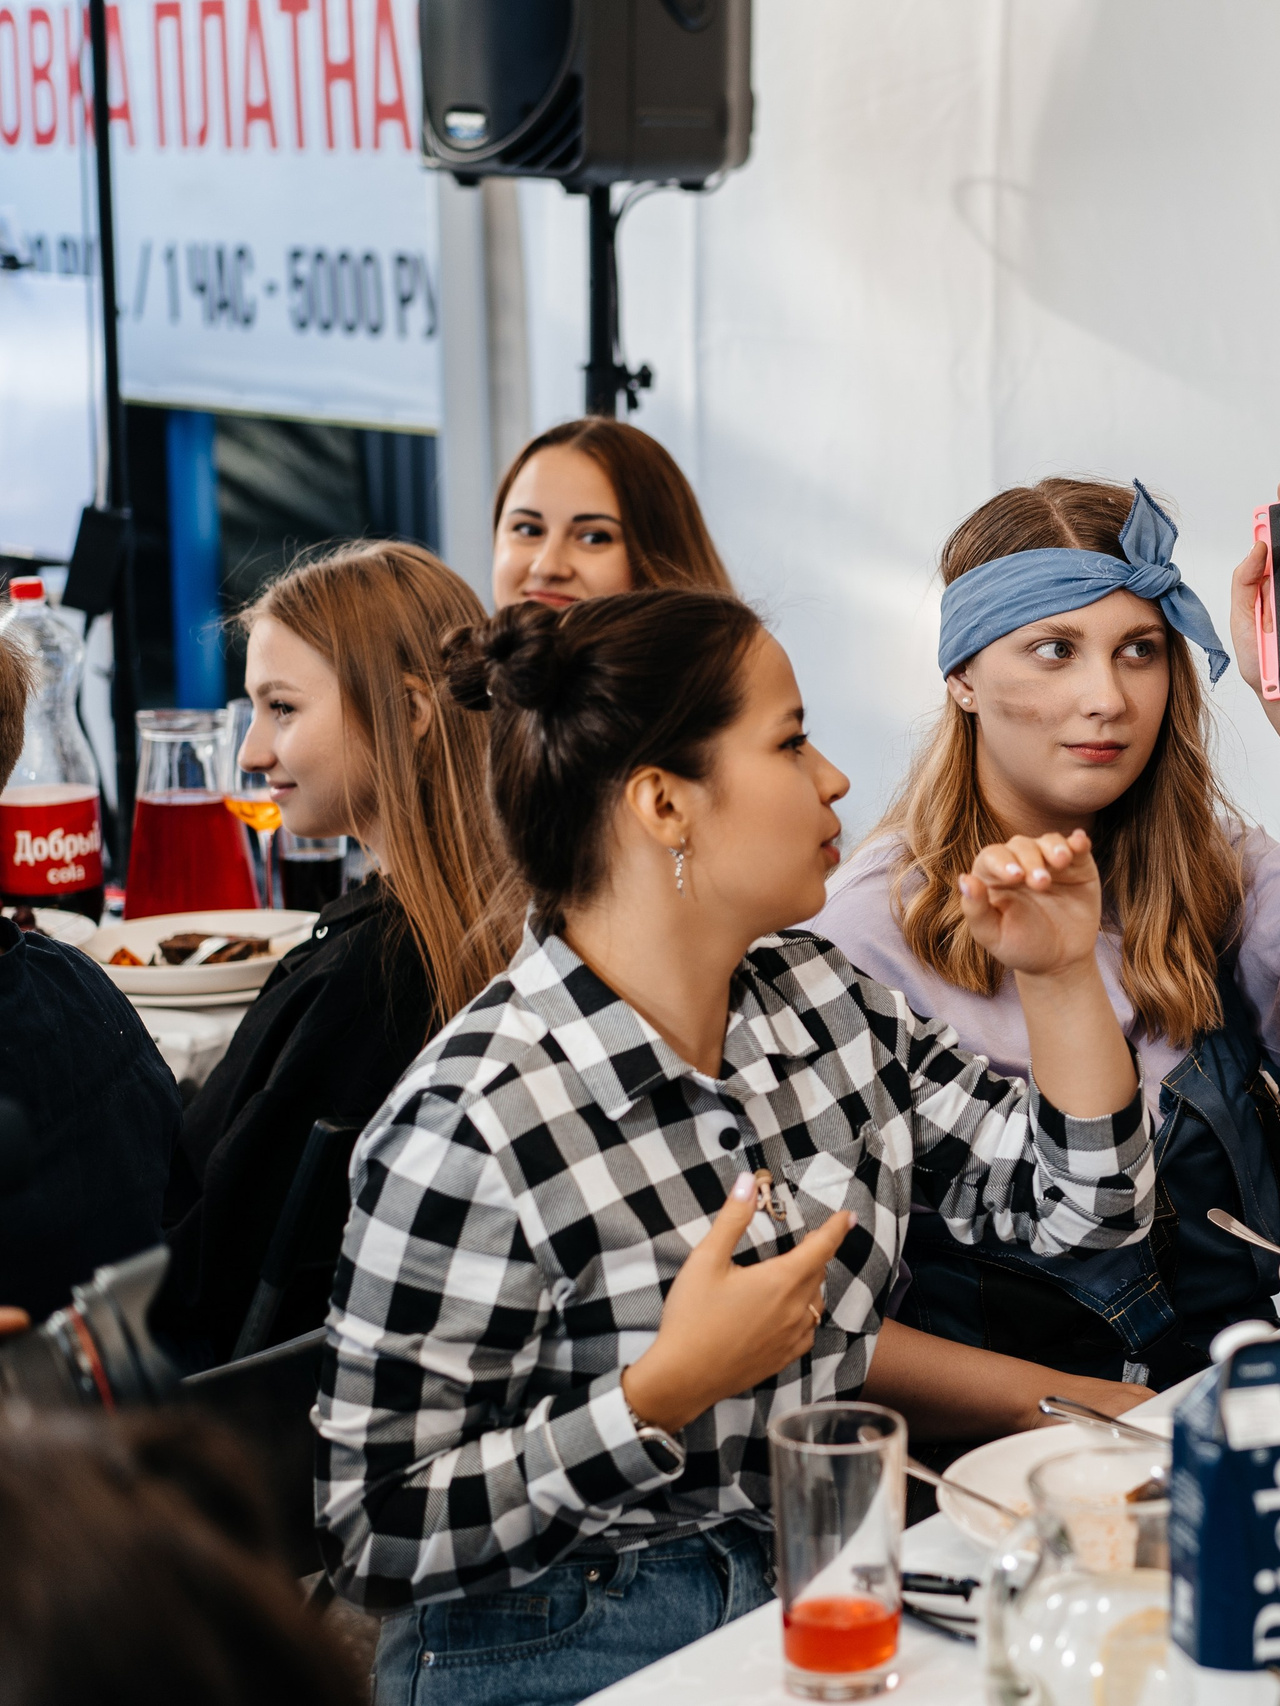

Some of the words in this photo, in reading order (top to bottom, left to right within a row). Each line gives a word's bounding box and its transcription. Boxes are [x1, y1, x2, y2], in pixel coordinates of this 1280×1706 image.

[164, 244, 181, 324] 1
[186, 241, 256, 328] ЧАС
[289, 247, 384, 336] 5000
[47, 863, 85, 885] cola
